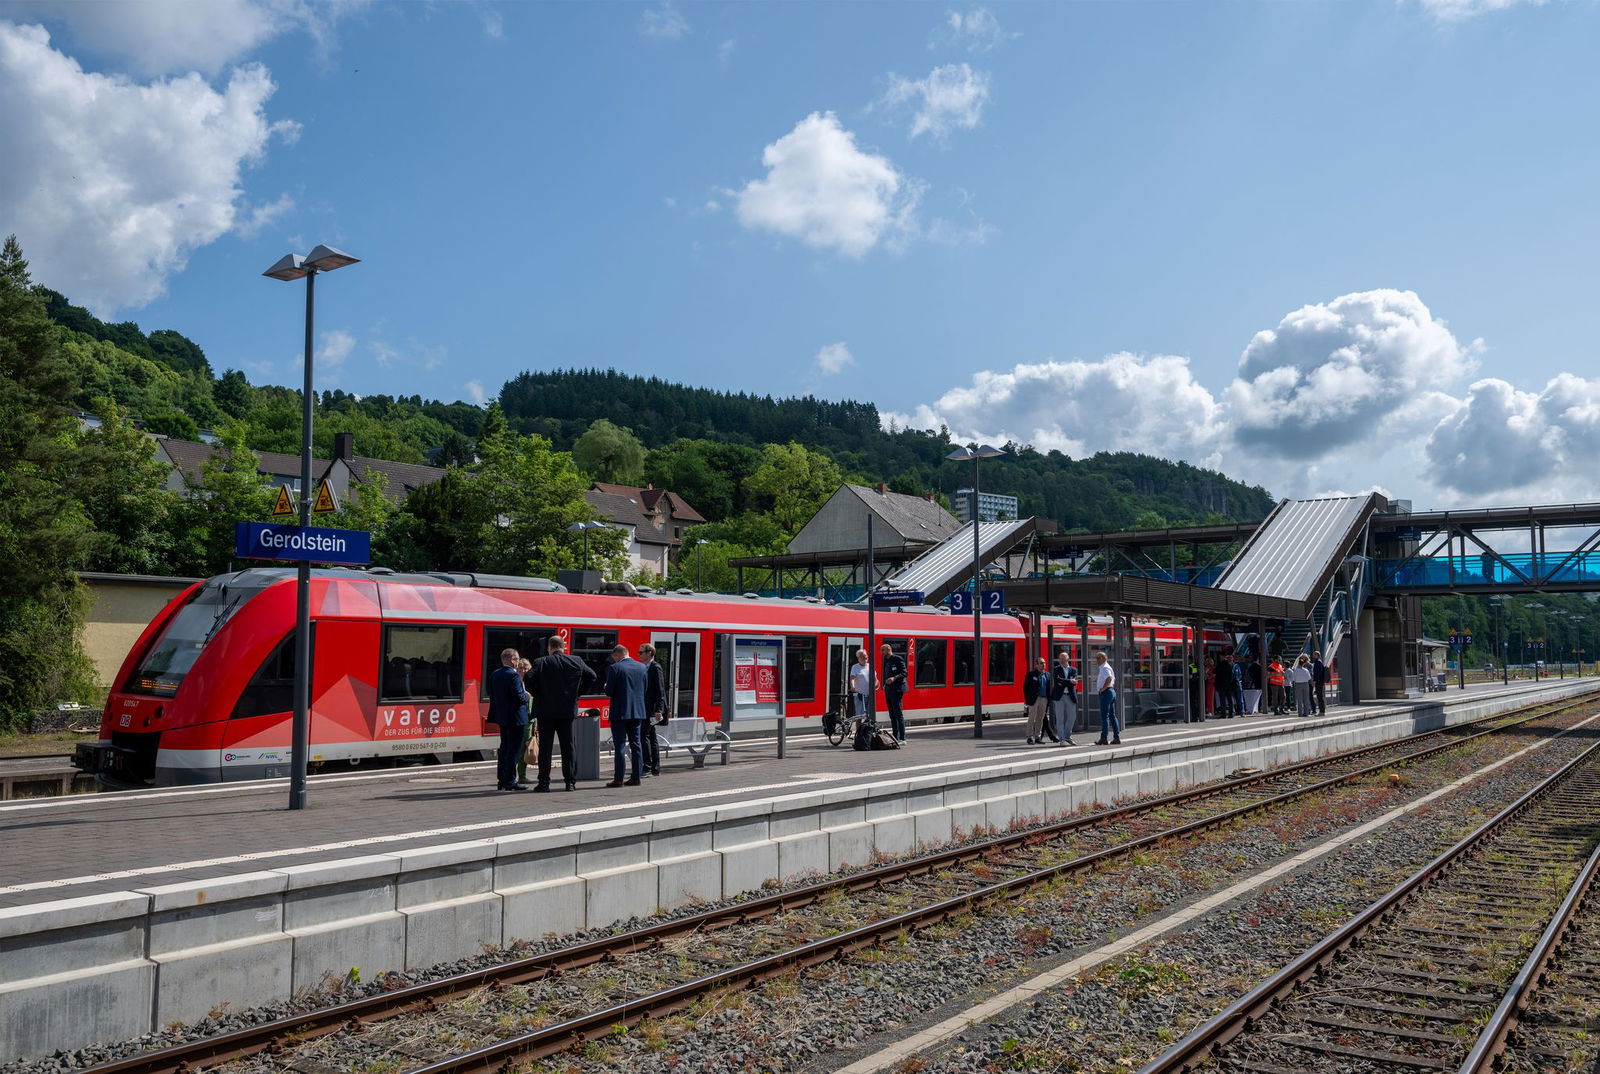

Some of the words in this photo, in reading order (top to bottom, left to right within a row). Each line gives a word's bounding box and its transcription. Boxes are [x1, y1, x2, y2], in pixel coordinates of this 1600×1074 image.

[260, 529, 346, 552] Gerolstein
[953, 593, 963, 610] 3
[990, 592, 1000, 609] 2
[560, 628, 568, 643] 2
[909, 638, 914, 650] 2
[120, 714, 131, 727] DB
[383, 708, 457, 726] vareo
[411, 727, 422, 735] FÜR
[434, 726, 456, 734] REGION
